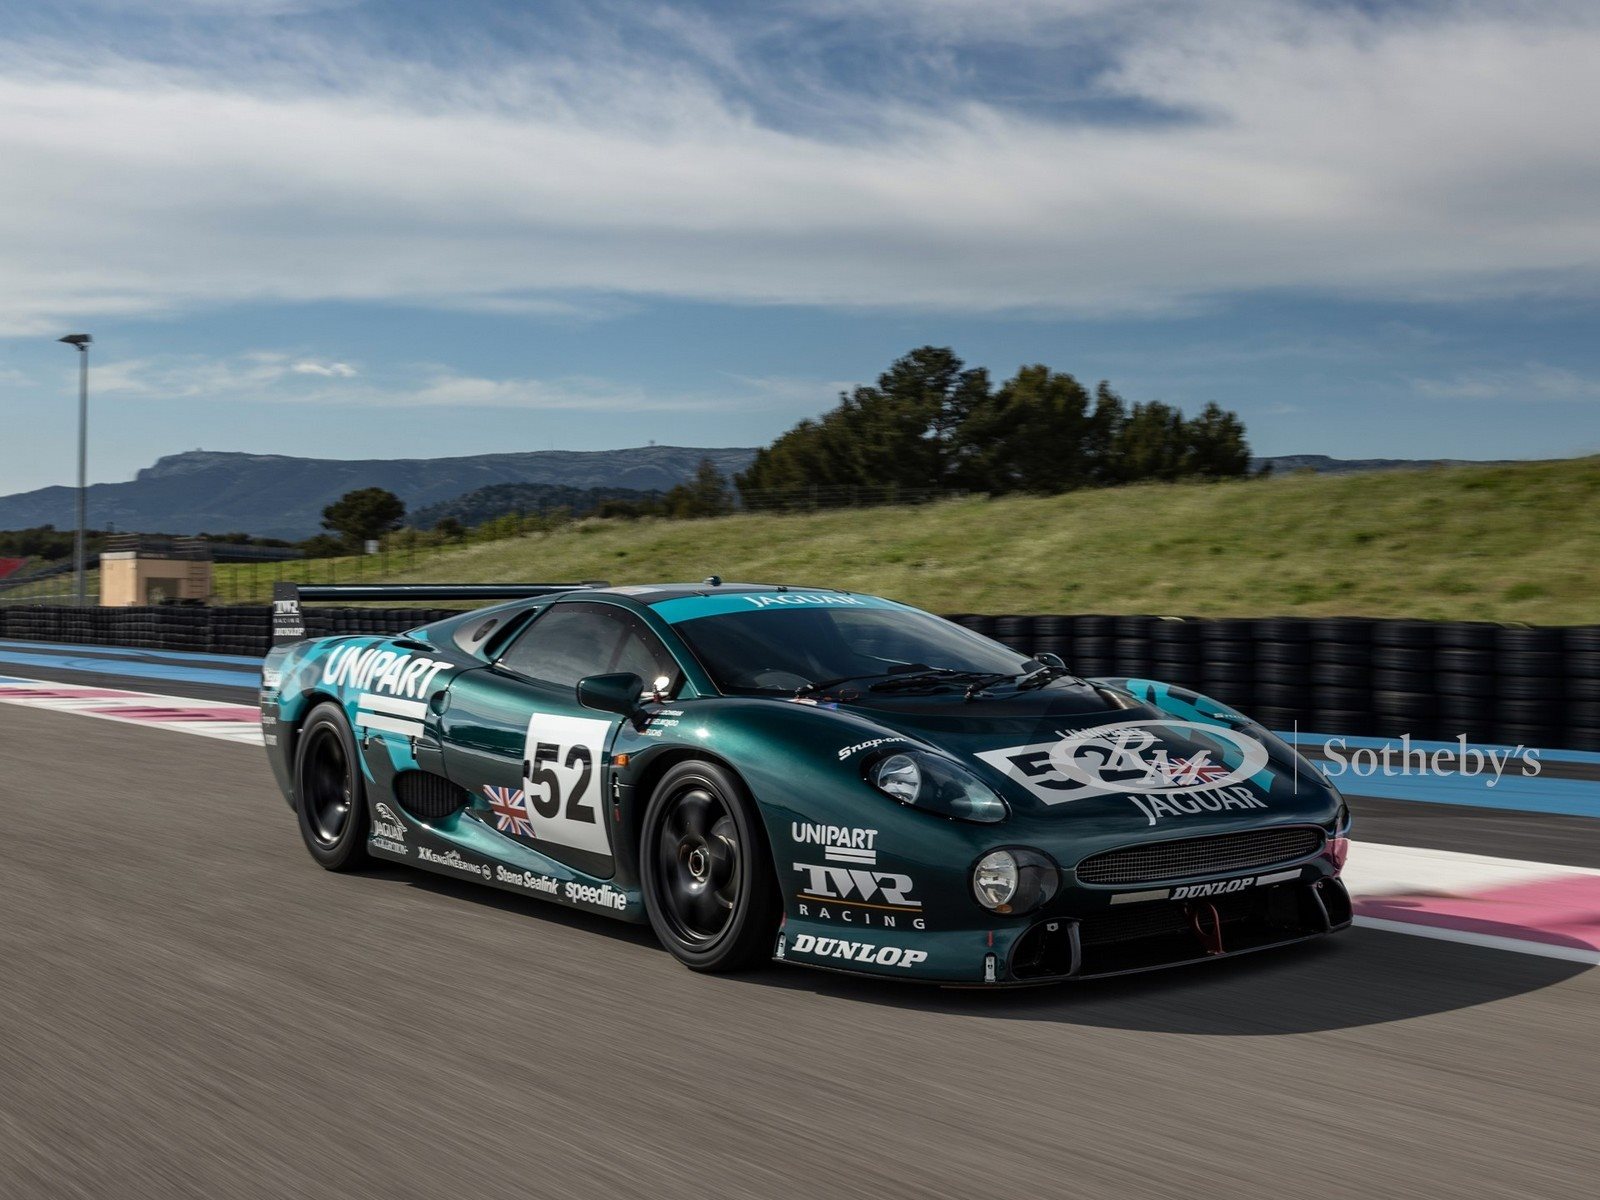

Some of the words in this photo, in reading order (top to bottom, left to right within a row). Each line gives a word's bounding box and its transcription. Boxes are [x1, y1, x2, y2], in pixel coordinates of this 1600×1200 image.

[273, 600, 299, 614] TWR
[743, 595, 866, 607] JAGUAR
[322, 645, 454, 699] UNIPART
[838, 737, 907, 761] Snap-on
[528, 741, 596, 824] 52
[1006, 745, 1148, 790] 52
[1127, 786, 1268, 826] JAGUAR
[374, 820, 405, 842] JAGUAR
[791, 821, 878, 850] UNIPART
[496, 865, 522, 886] Stena
[523, 871, 559, 895] Sealink
[792, 862, 923, 907] TWR
[1170, 877, 1256, 901] DUNLOP
[565, 881, 627, 911] speedline
[800, 904, 926, 930] RACING
[791, 933, 928, 968] DUNLOP
